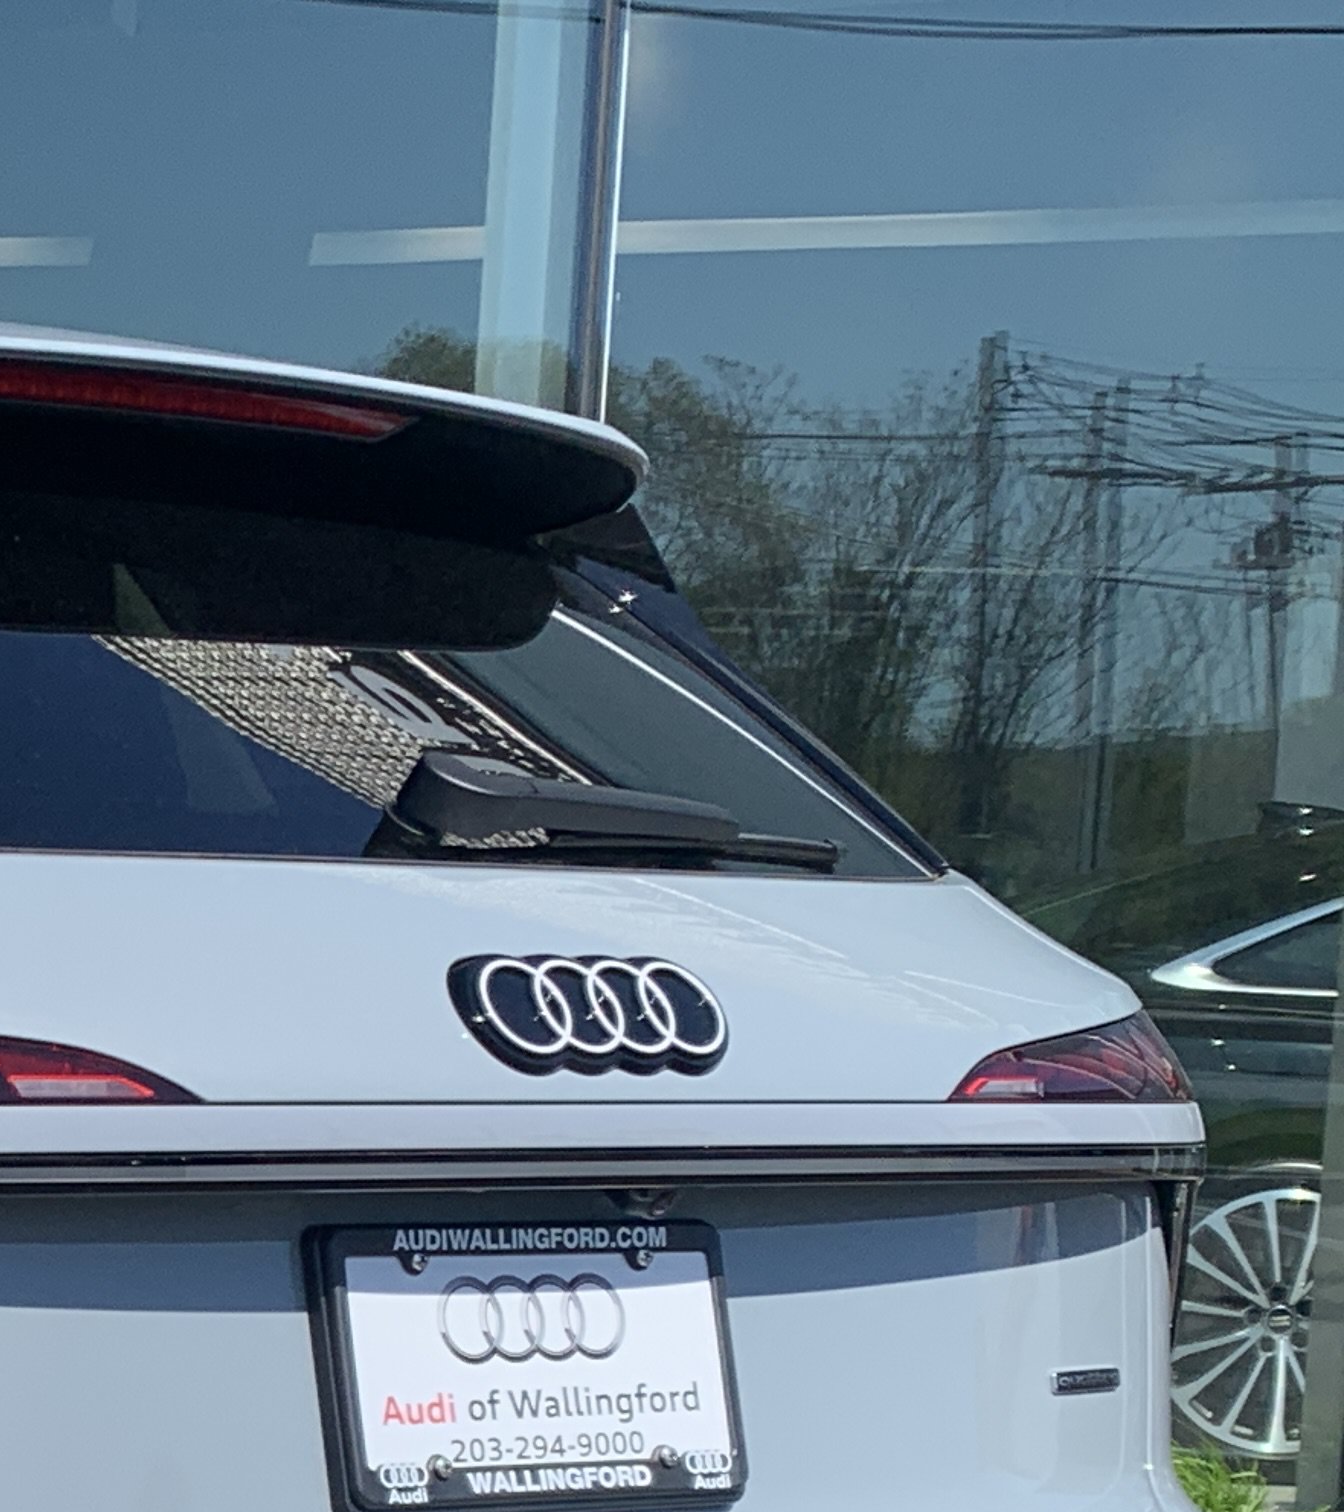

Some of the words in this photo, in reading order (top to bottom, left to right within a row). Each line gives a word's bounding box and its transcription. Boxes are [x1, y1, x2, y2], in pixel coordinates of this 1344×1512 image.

[393, 1227, 667, 1251] AUDIWALLINGFORD.COM
[383, 1393, 457, 1425] Audi
[468, 1390, 500, 1421] of
[509, 1381, 700, 1423] Wallingford
[451, 1431, 645, 1463] 203-294-9000
[467, 1466, 651, 1494] WALLINGFORD
[694, 1473, 731, 1489] Audi
[388, 1487, 428, 1504] Audi
